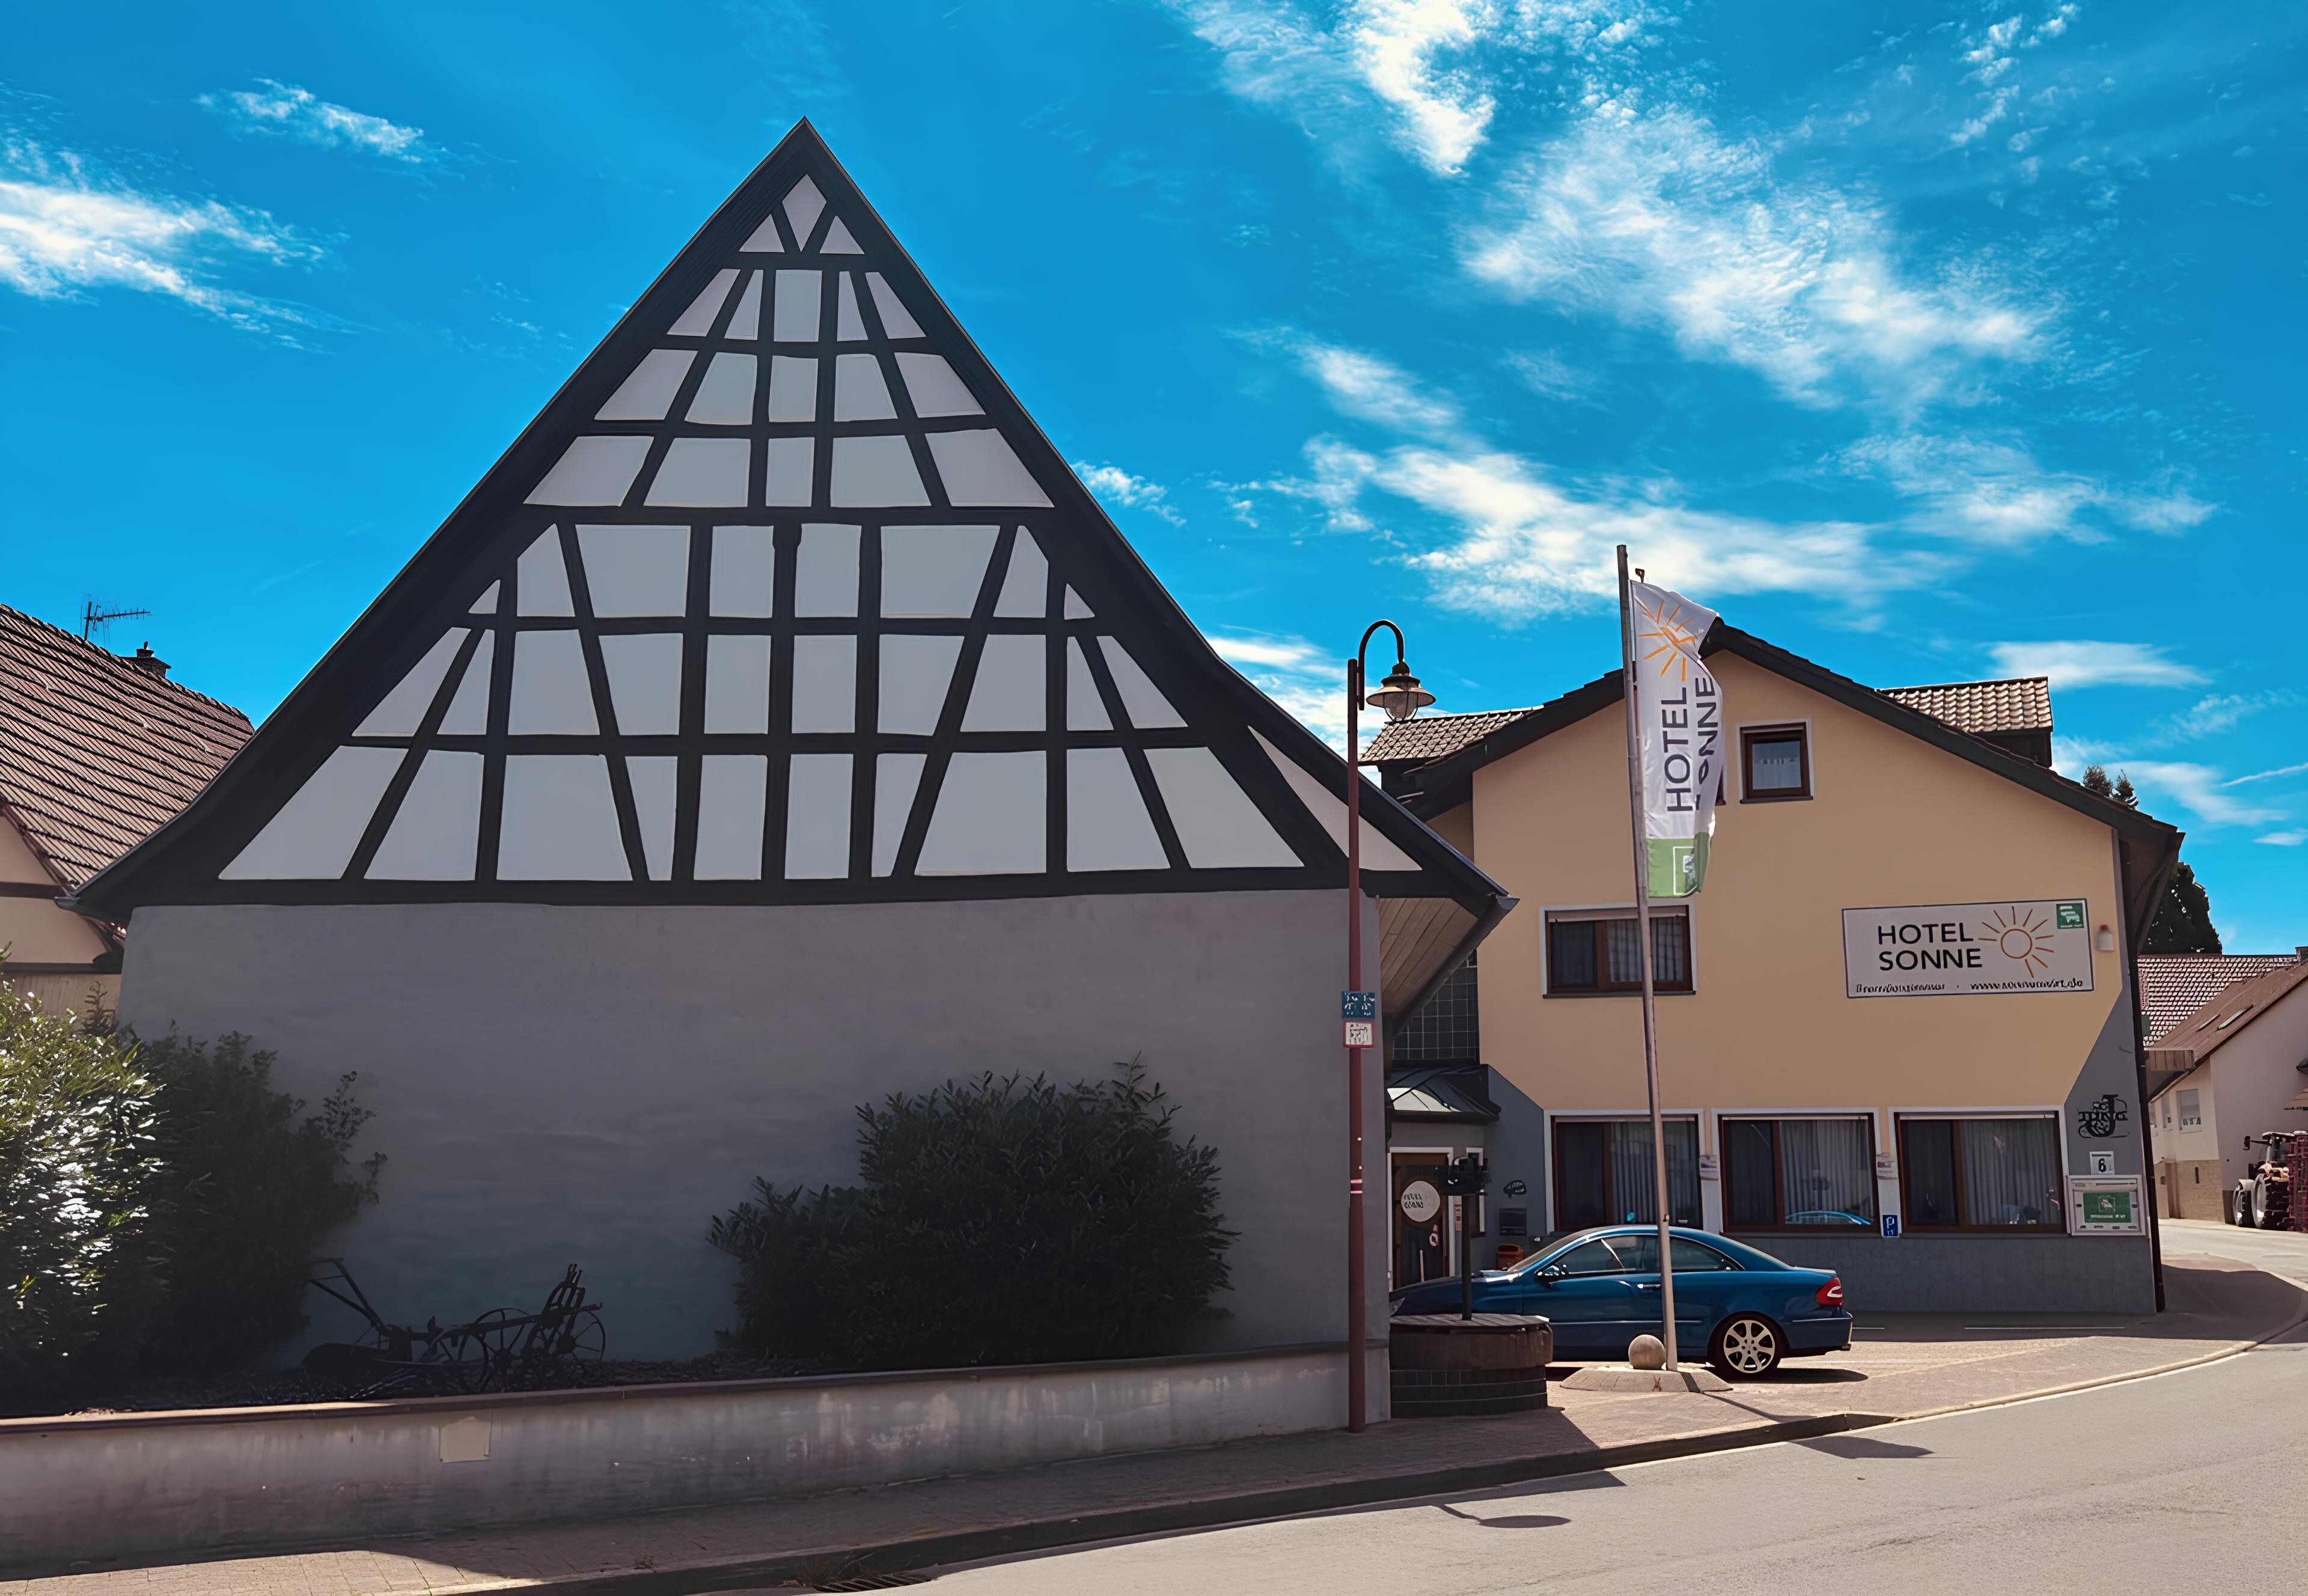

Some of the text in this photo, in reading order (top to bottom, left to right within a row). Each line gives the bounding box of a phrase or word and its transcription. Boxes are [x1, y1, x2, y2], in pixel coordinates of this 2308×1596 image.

[1661, 687, 1693, 811] HOTEL
[1695, 677, 1718, 811] ONNE
[1878, 922, 1974, 945] HOTEL
[1879, 948, 1982, 971] SONNE
